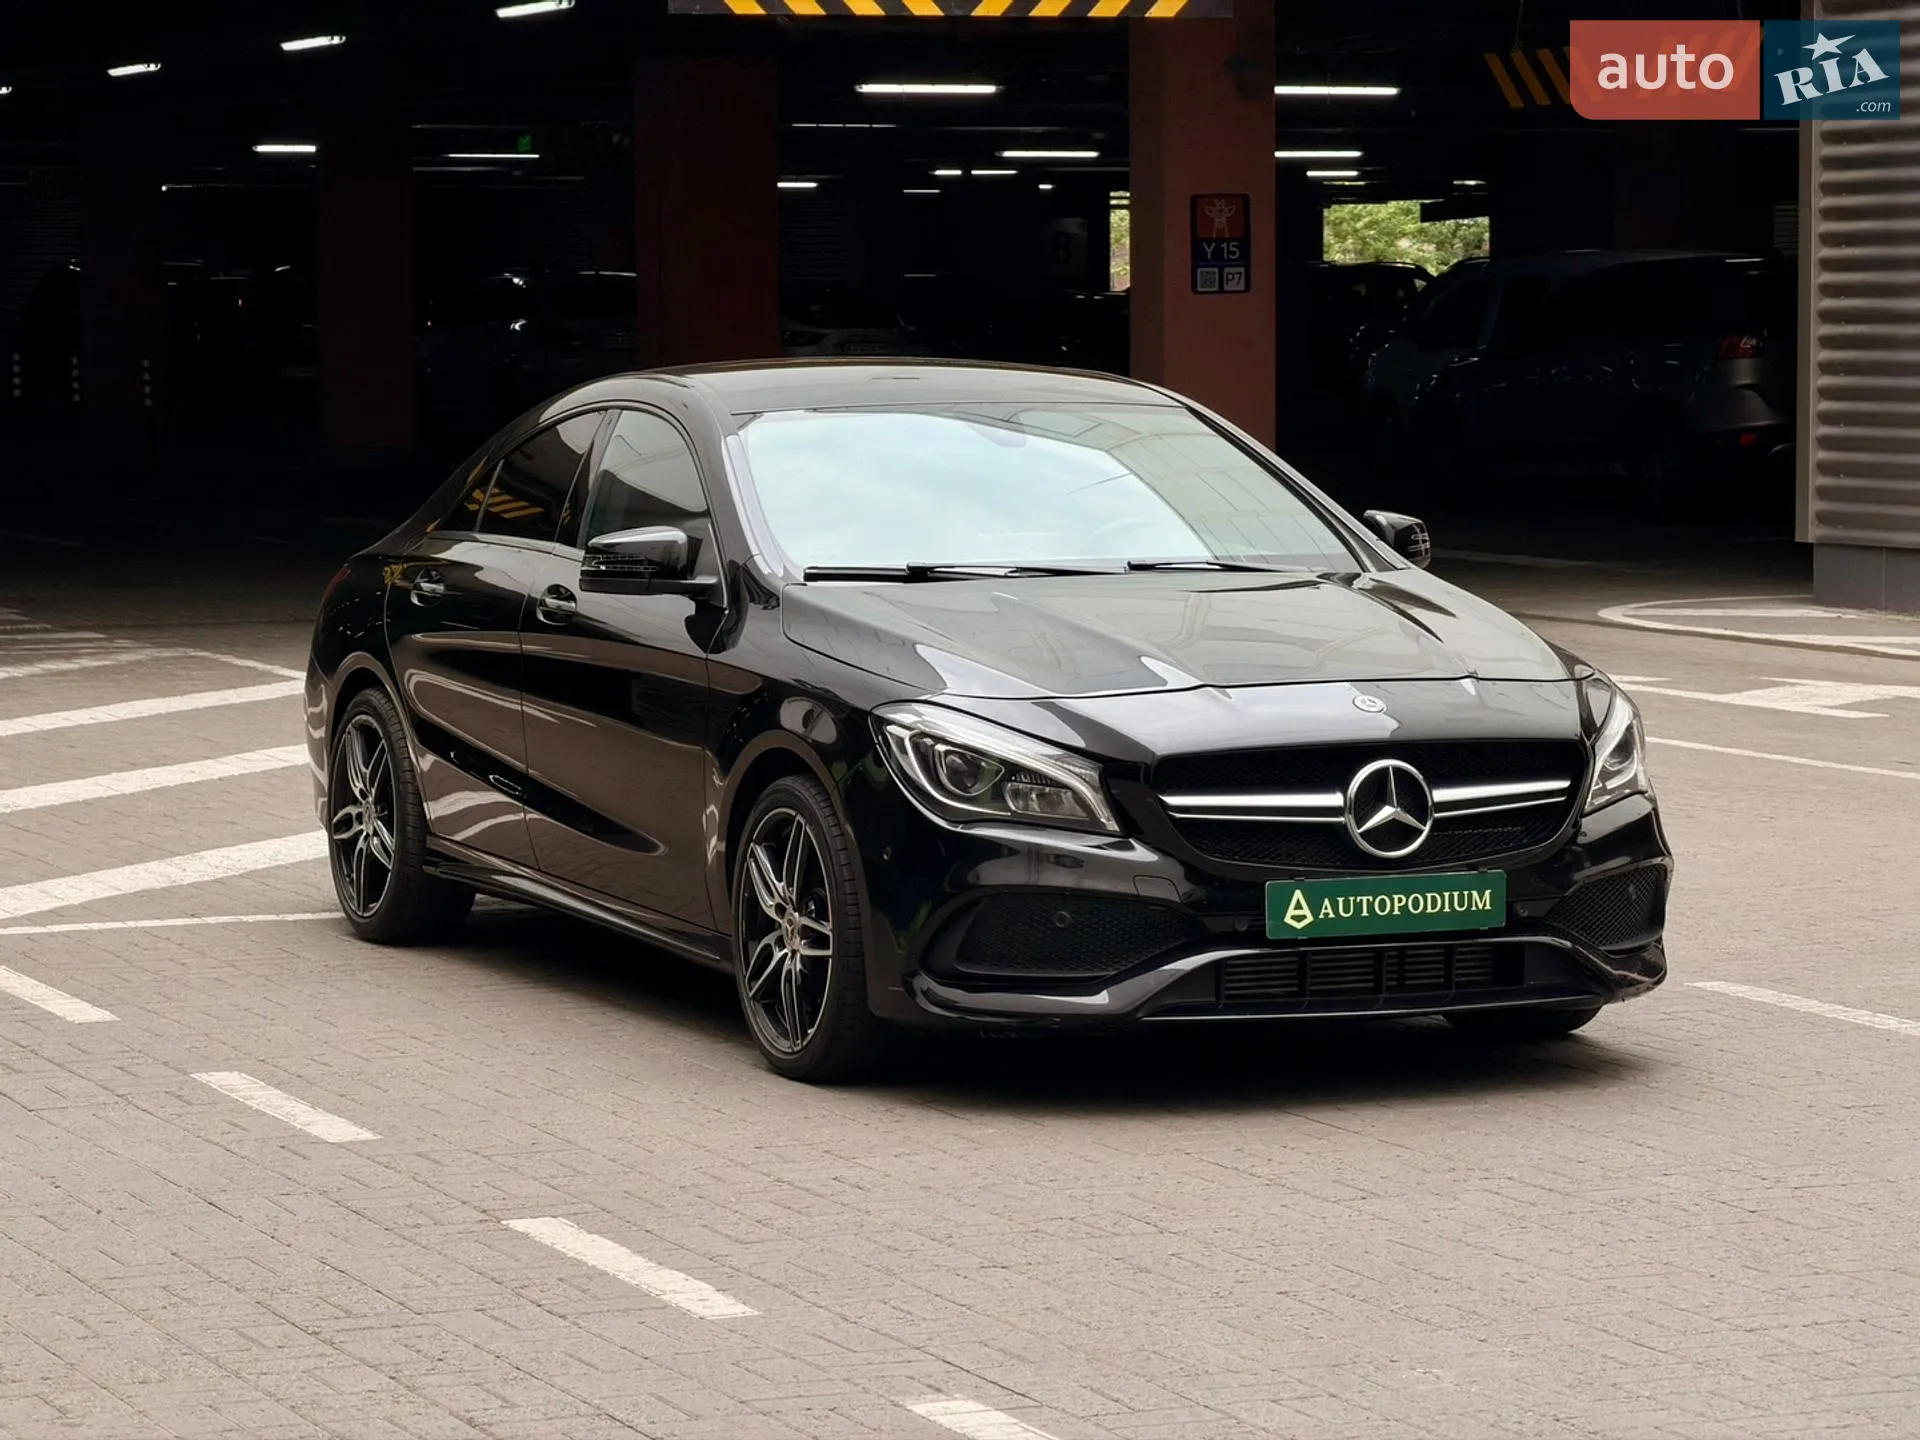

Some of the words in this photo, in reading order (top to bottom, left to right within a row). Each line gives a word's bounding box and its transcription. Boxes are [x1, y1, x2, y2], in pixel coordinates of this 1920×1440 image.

[1202, 241, 1216, 260] Y
[1220, 241, 1240, 260] 15
[1226, 271, 1242, 287] P7
[1318, 889, 1492, 919] AUTOPODIUM
